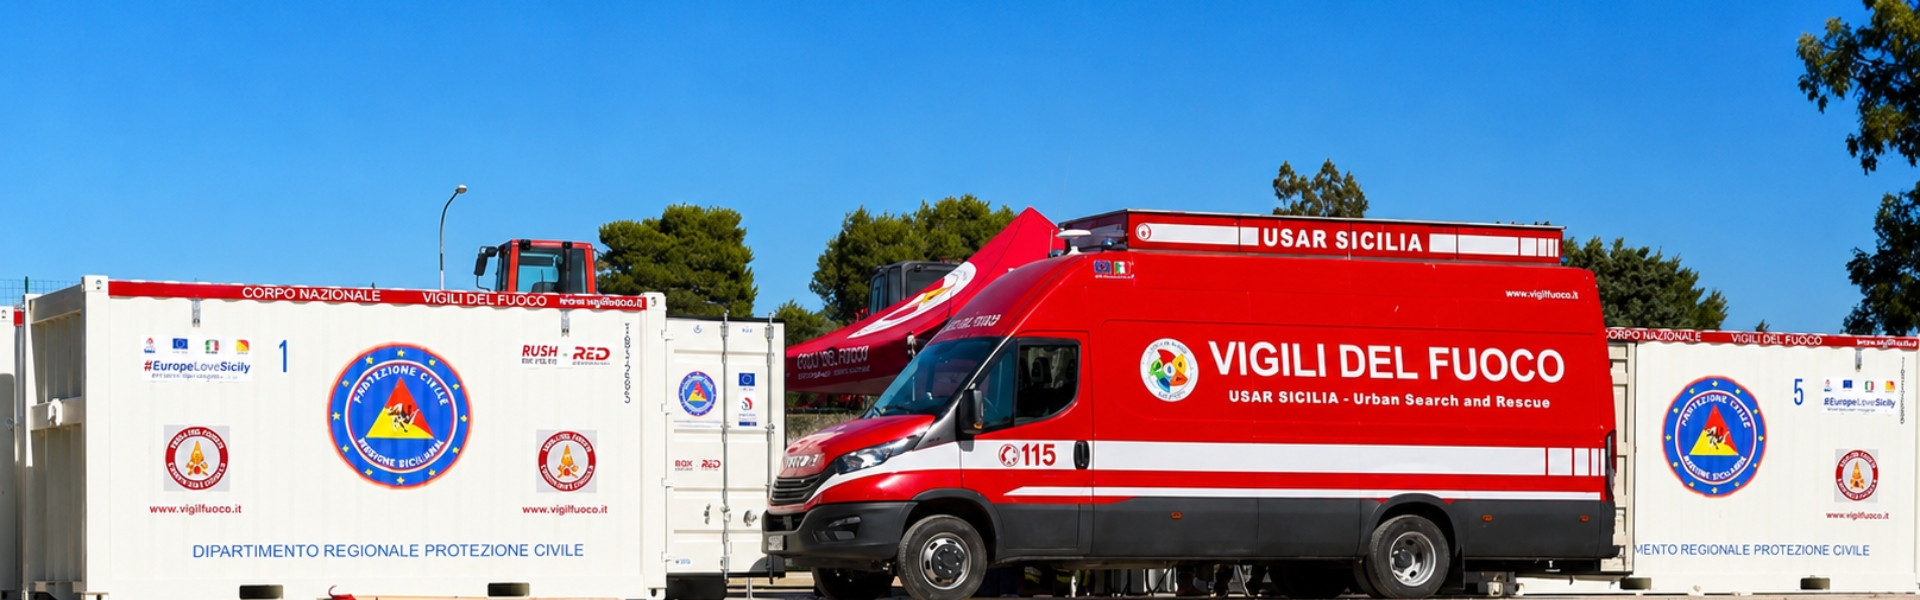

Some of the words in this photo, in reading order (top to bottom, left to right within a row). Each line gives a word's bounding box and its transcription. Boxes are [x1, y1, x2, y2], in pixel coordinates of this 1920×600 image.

[1262, 227, 1327, 249] USAR
[1335, 230, 1423, 252] SICILIA
[242, 286, 296, 299] CORPO
[300, 288, 381, 302] NAZIONALE
[422, 292, 463, 304] VIGILI
[466, 294, 494, 305] DEL
[498, 294, 547, 306] FUOCO
[1643, 330, 1702, 342] NAZIONALE
[1731, 333, 1761, 344] VIGILI
[1762, 334, 1783, 345] DEL
[1785, 334, 1822, 346] FUOCO
[279, 339, 288, 373] 1
[521, 344, 558, 357] RUSH
[572, 346, 611, 361] RED
[144, 360, 251, 374] #EuropeLoveSicily
[1207, 341, 1327, 377] VIGILI
[1339, 344, 1418, 380] DEL
[1428, 346, 1565, 383] FUOCO
[1229, 389, 1273, 403] USAR
[1278, 391, 1339, 404] SICILIA
[1353, 392, 1399, 405] Urban
[1405, 393, 1459, 406] Search
[1463, 395, 1491, 407] and
[1496, 396, 1551, 408] Rescue
[1793, 378, 1804, 406] 5
[1021, 443, 1056, 466] 115
[149, 504, 242, 516] www.vigilfuoco.it
[522, 505, 608, 516] www.vigilfuoco.it
[193, 544, 319, 558] DIPARTIMENTO
[324, 543, 419, 557] REGIONALE
[424, 543, 529, 557] PROTEZIONE
[534, 543, 584, 557] CIVILE
[1680, 543, 1750, 556] REGIONALE
[1754, 544, 1830, 556] PROTEZIONE
[1833, 544, 1871, 556] CIVILE
